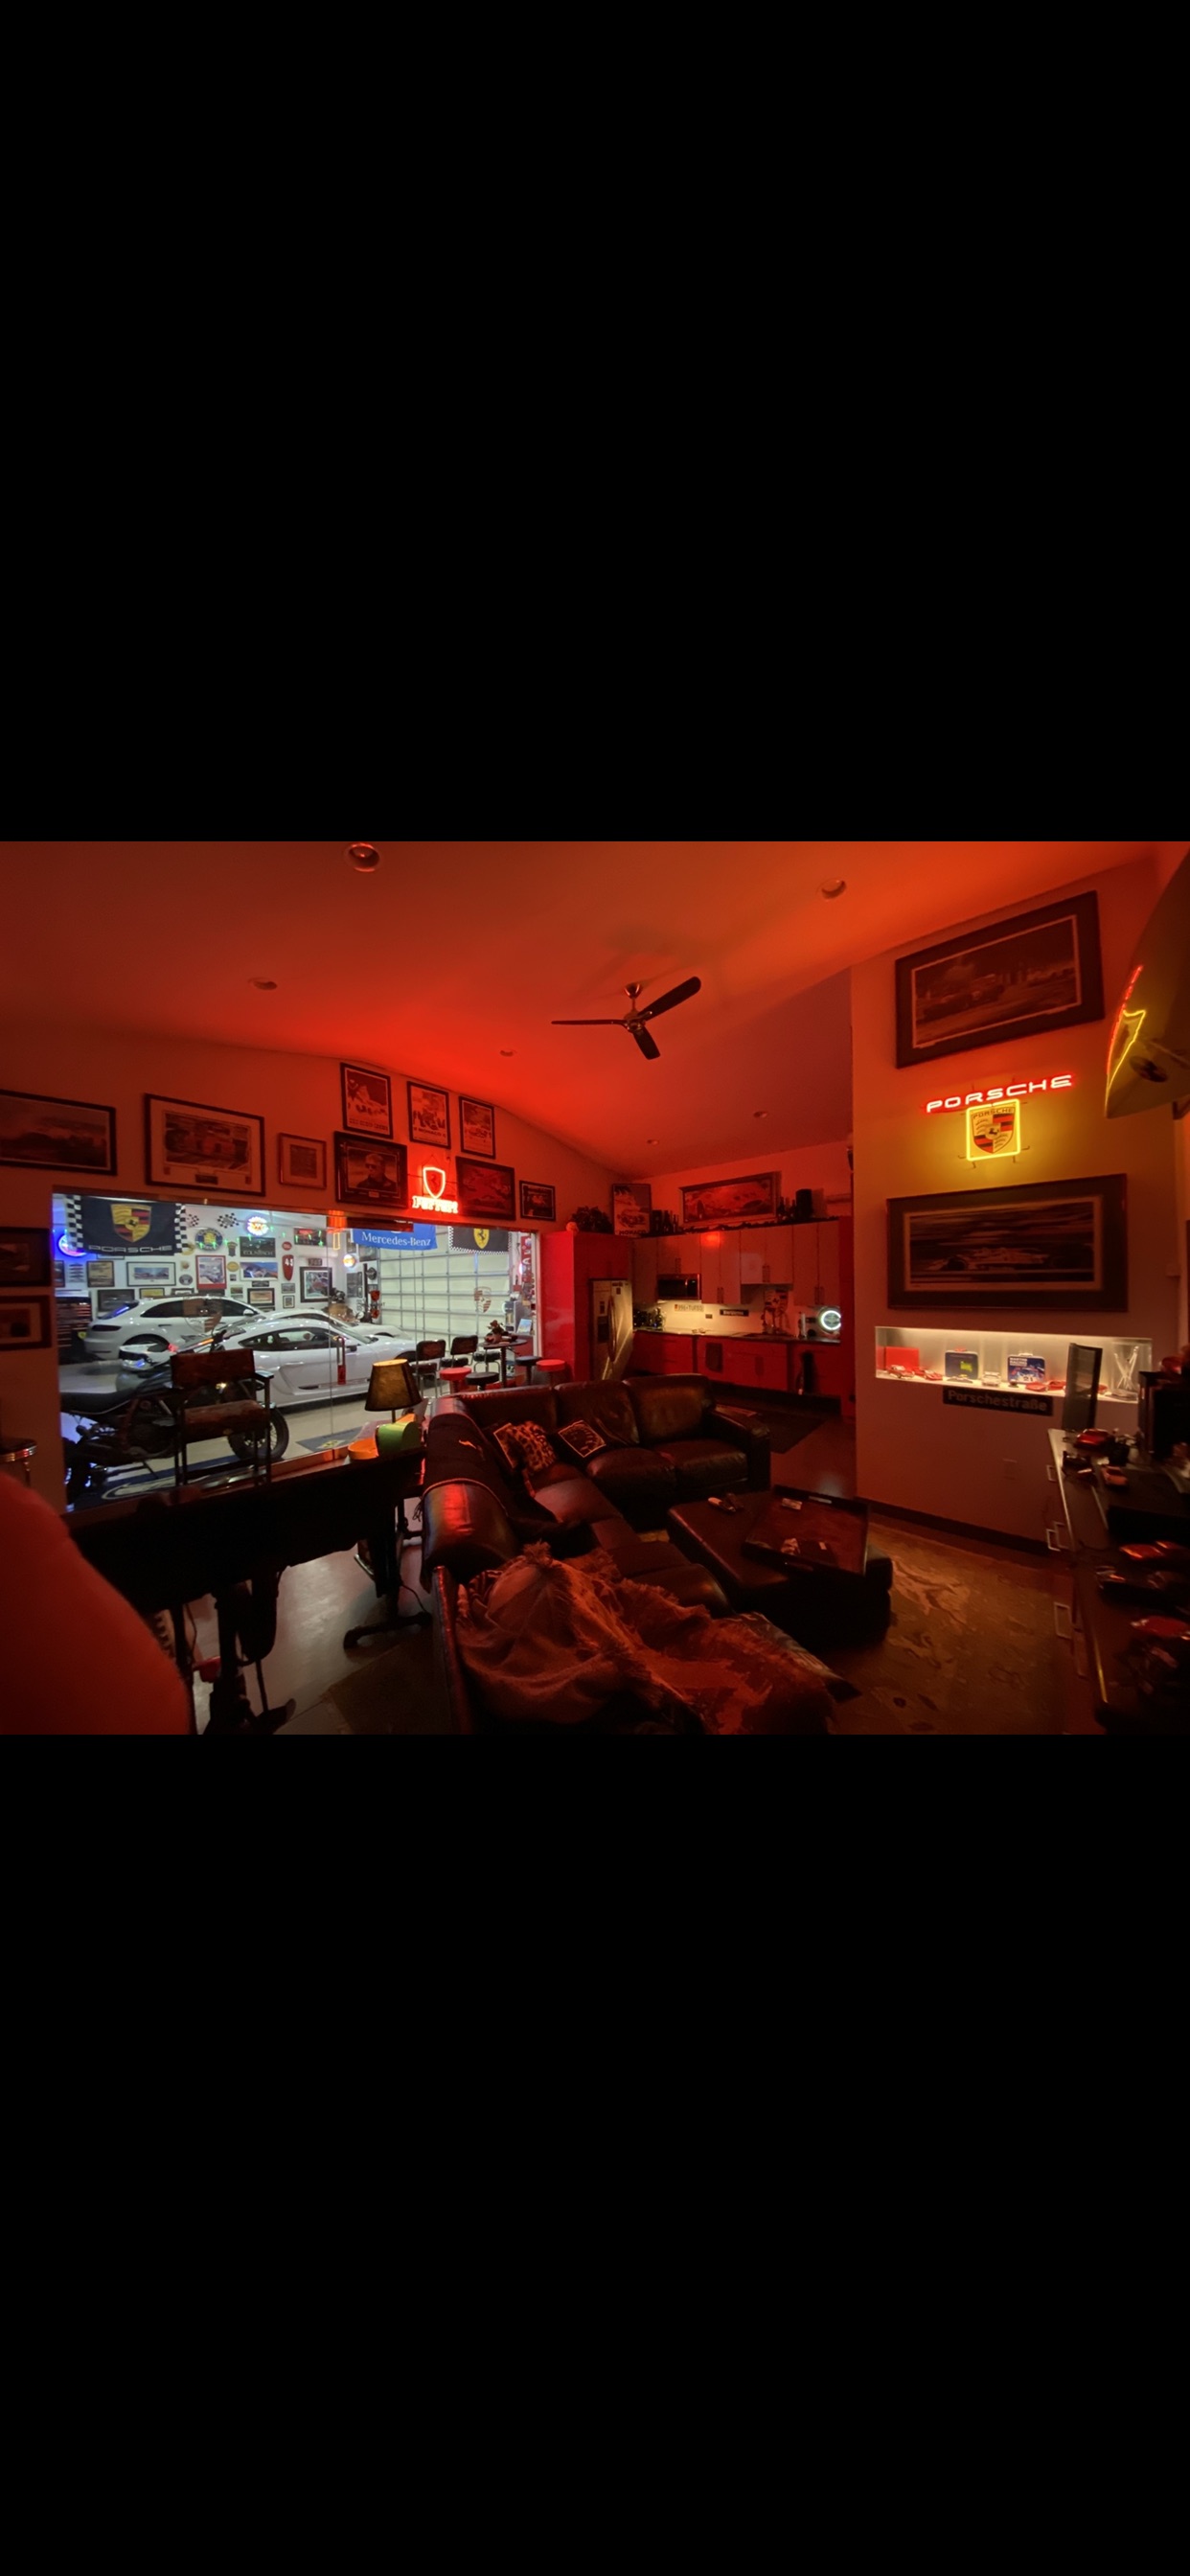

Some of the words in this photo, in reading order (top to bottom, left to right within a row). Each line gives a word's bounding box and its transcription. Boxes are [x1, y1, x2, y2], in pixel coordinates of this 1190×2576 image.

[926, 1074, 1073, 1113] PORSCHE
[972, 1107, 1015, 1119] PORSCHE
[361, 1231, 431, 1247] Mercedes-Benz
[87, 1244, 173, 1254] PORSCHE
[948, 1390, 1048, 1412] Porschestraße
